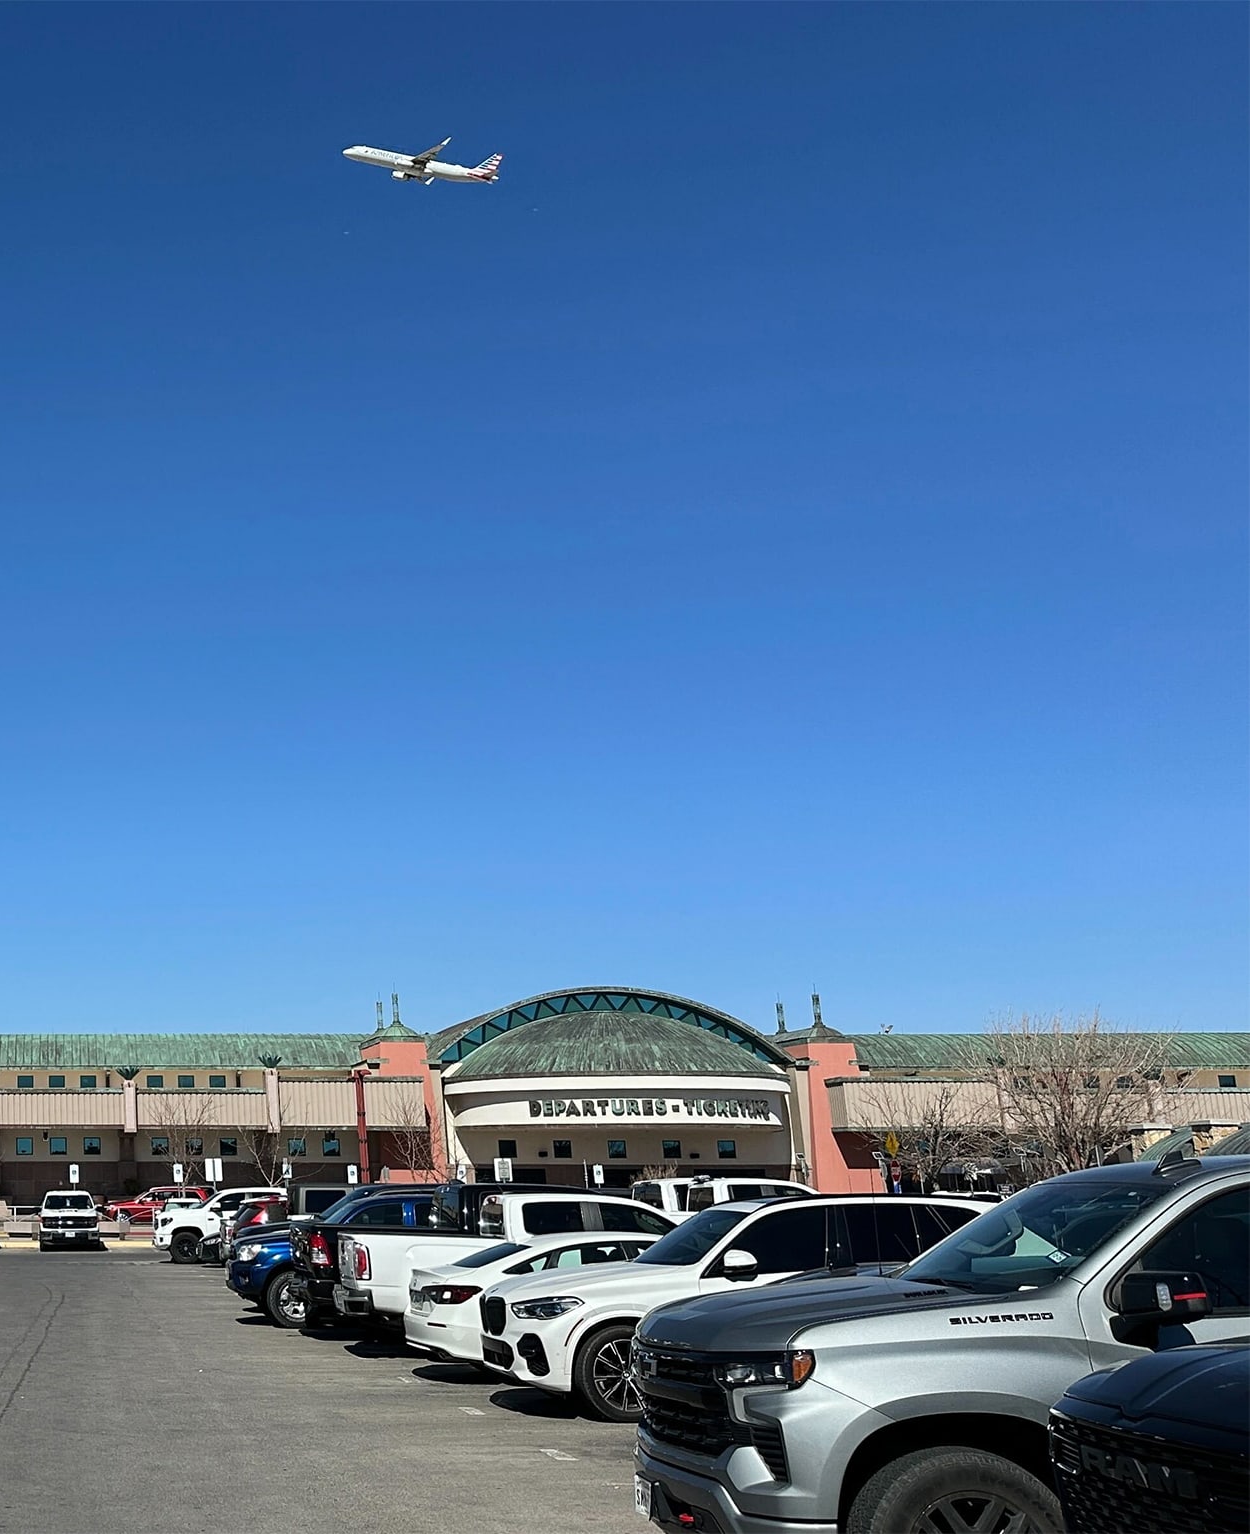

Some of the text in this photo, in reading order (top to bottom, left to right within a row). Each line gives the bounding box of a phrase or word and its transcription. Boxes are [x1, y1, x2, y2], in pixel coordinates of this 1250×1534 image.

[529, 1099, 668, 1118] DEPARTURES
[949, 1312, 1054, 1325] SILVERADO
[1080, 1444, 1199, 1500] RAM
